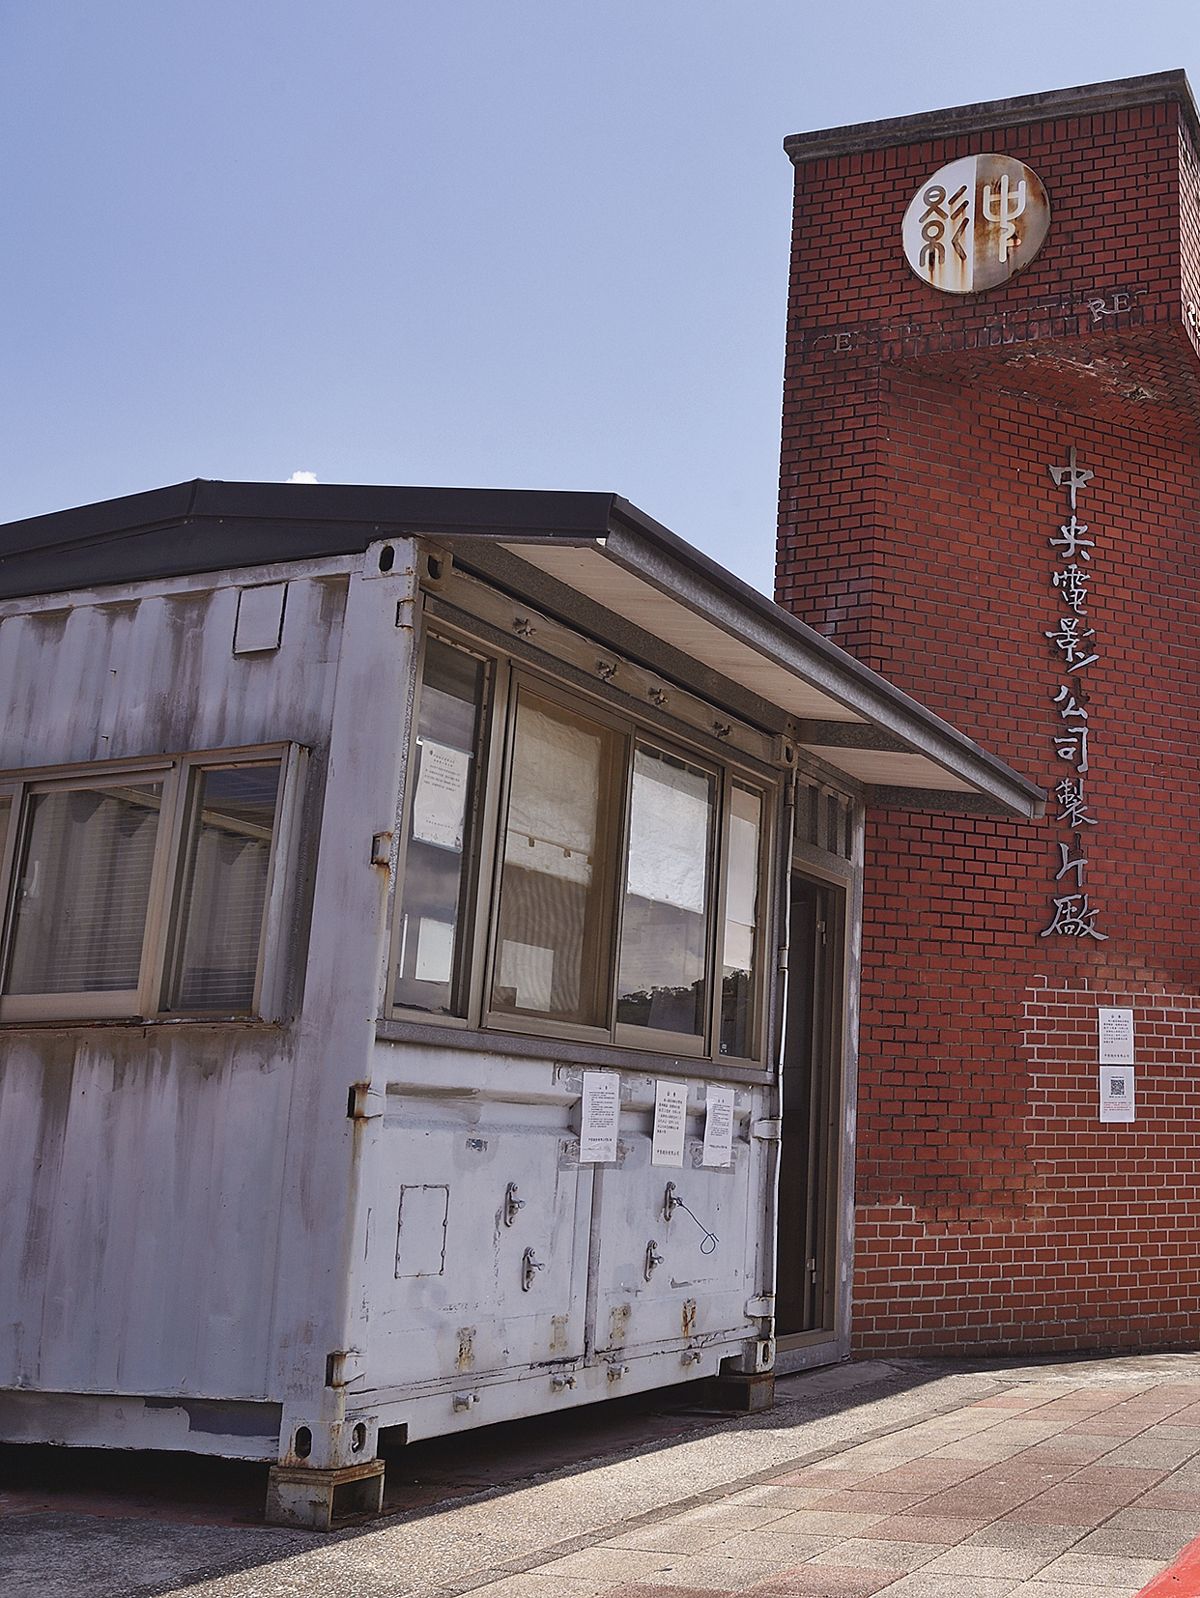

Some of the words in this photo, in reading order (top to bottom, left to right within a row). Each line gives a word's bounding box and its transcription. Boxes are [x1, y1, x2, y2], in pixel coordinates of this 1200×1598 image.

[1041, 446, 1109, 941] 中央電影公司製片廠
